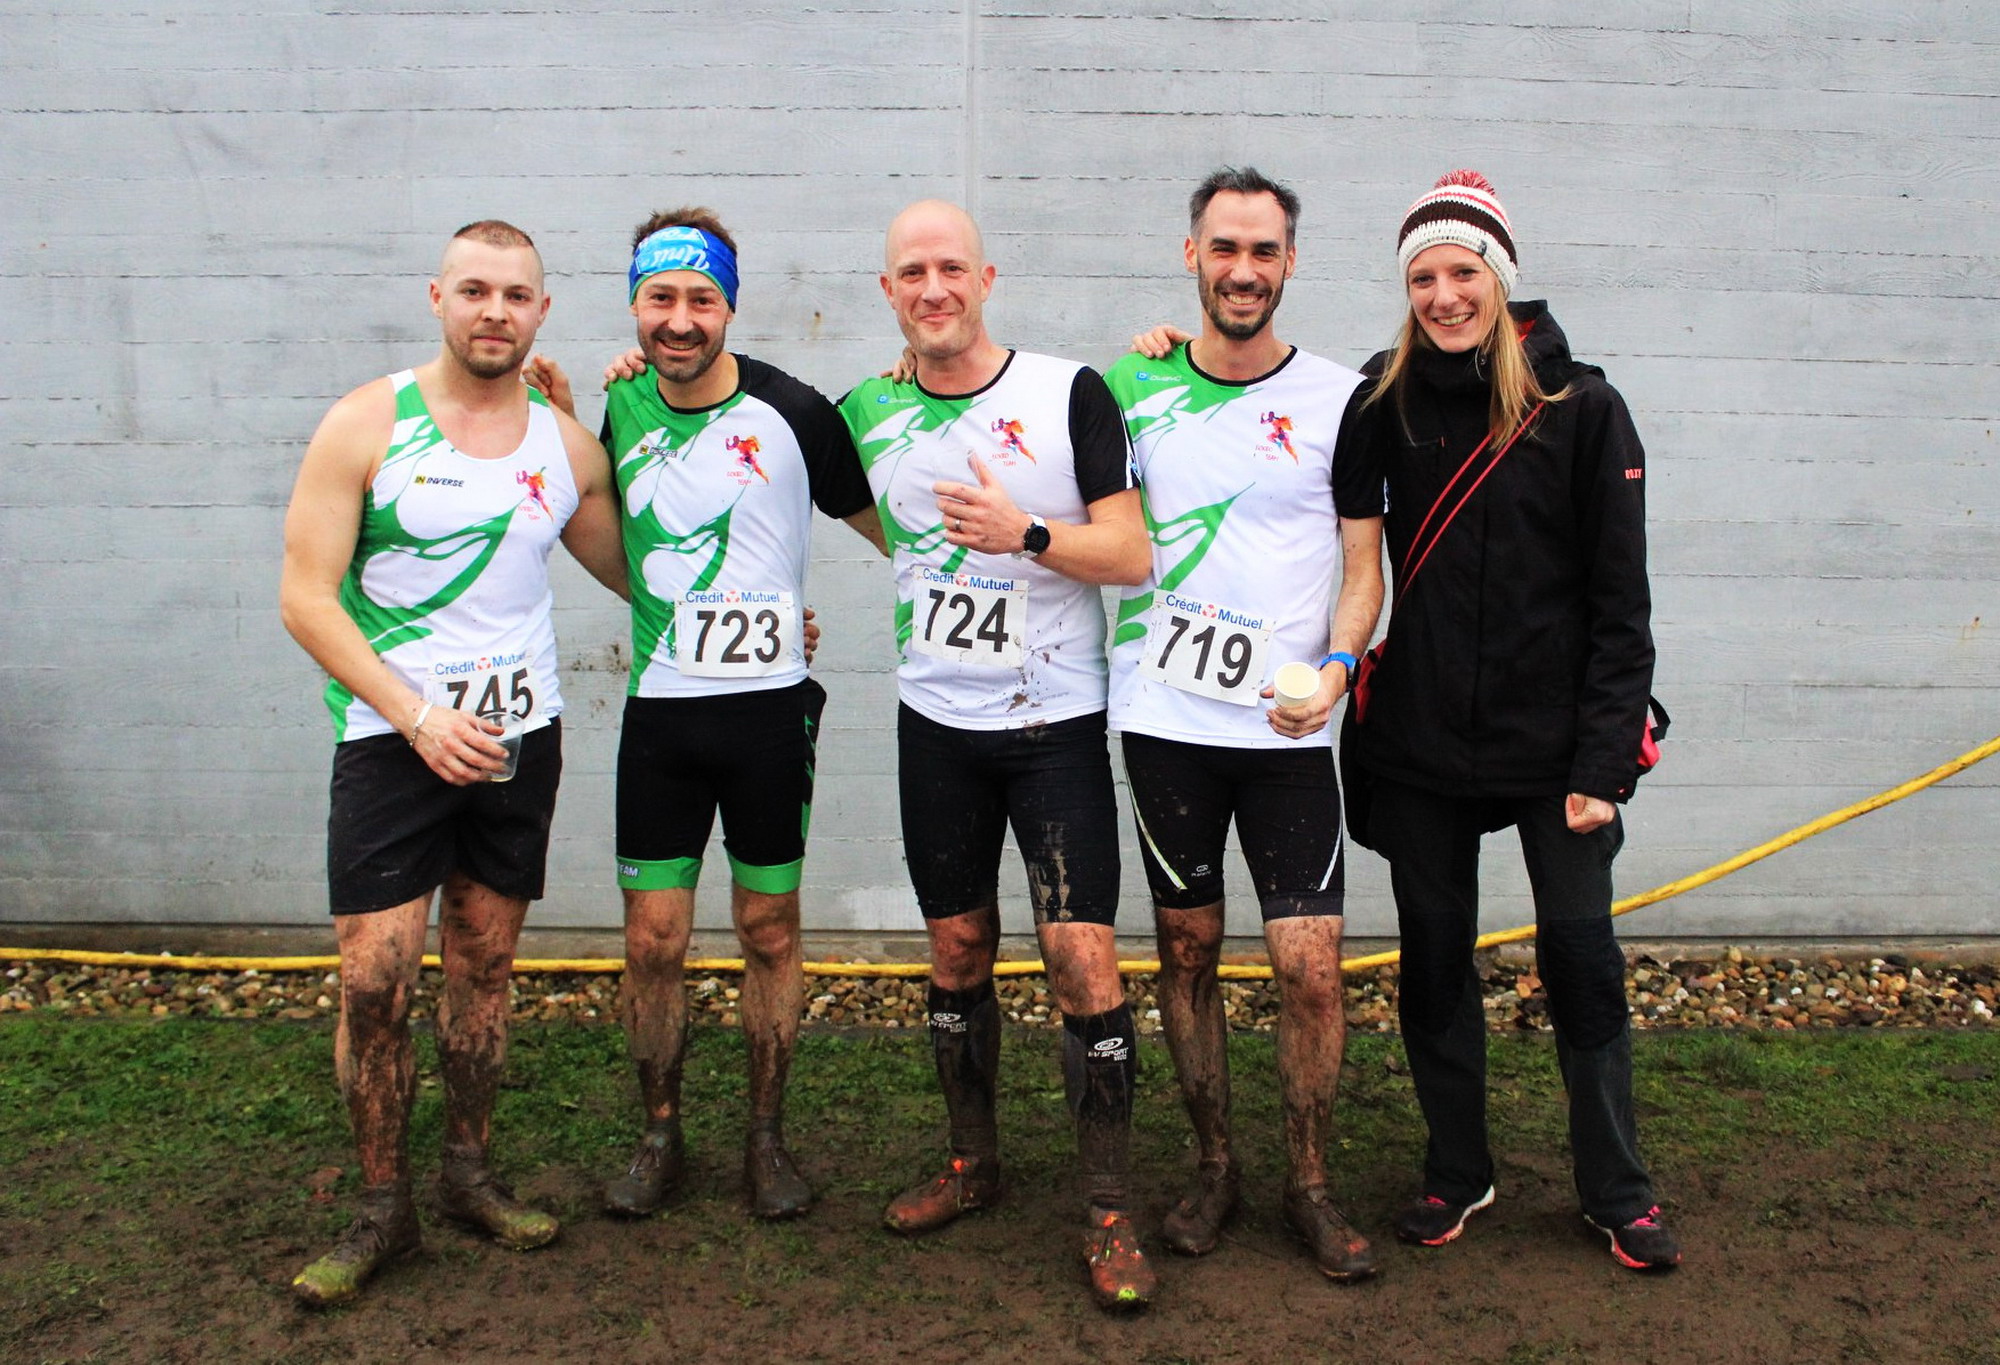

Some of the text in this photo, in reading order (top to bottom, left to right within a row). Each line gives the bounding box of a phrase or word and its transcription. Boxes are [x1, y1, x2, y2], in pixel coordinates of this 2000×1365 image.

[426, 477, 464, 488] INVERSE
[685, 590, 780, 603] Crédit Mutuel
[969, 576, 1014, 592] Mutuel
[924, 588, 1010, 653] 724
[1165, 594, 1264, 630] Crédit Mutuel
[694, 609, 781, 664] 723
[1157, 615, 1253, 689] 719
[435, 660, 476, 675] Crédit
[446, 667, 534, 727] 745
[618, 864, 638, 877] EAM
